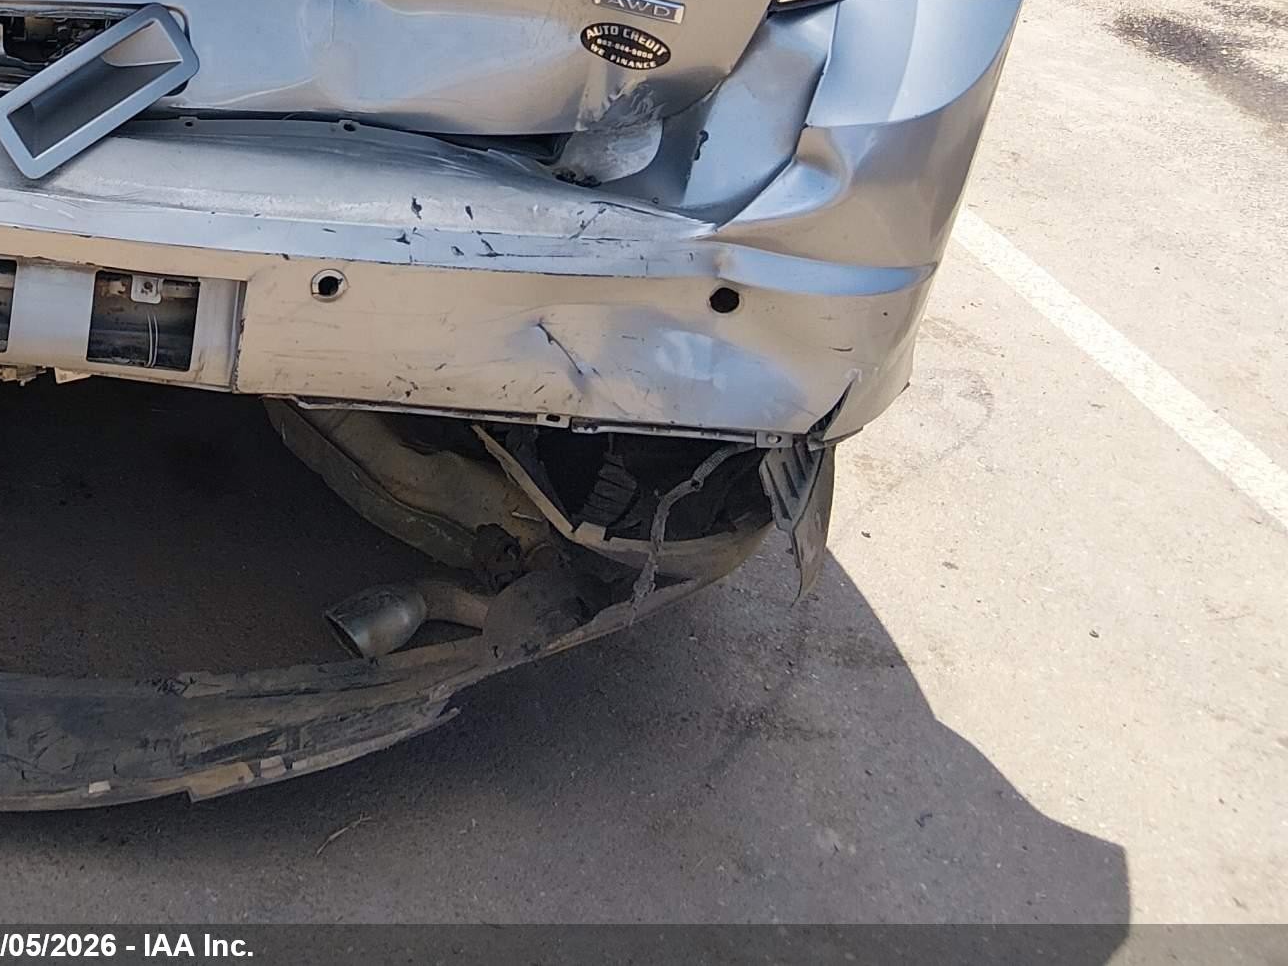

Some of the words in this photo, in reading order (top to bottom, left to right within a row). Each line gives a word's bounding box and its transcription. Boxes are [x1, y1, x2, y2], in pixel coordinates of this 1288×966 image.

[586, 25, 619, 40] AUTO
[623, 28, 668, 56] CREDIT
[590, 43, 606, 56] WE
[610, 55, 657, 69] FINANCE
